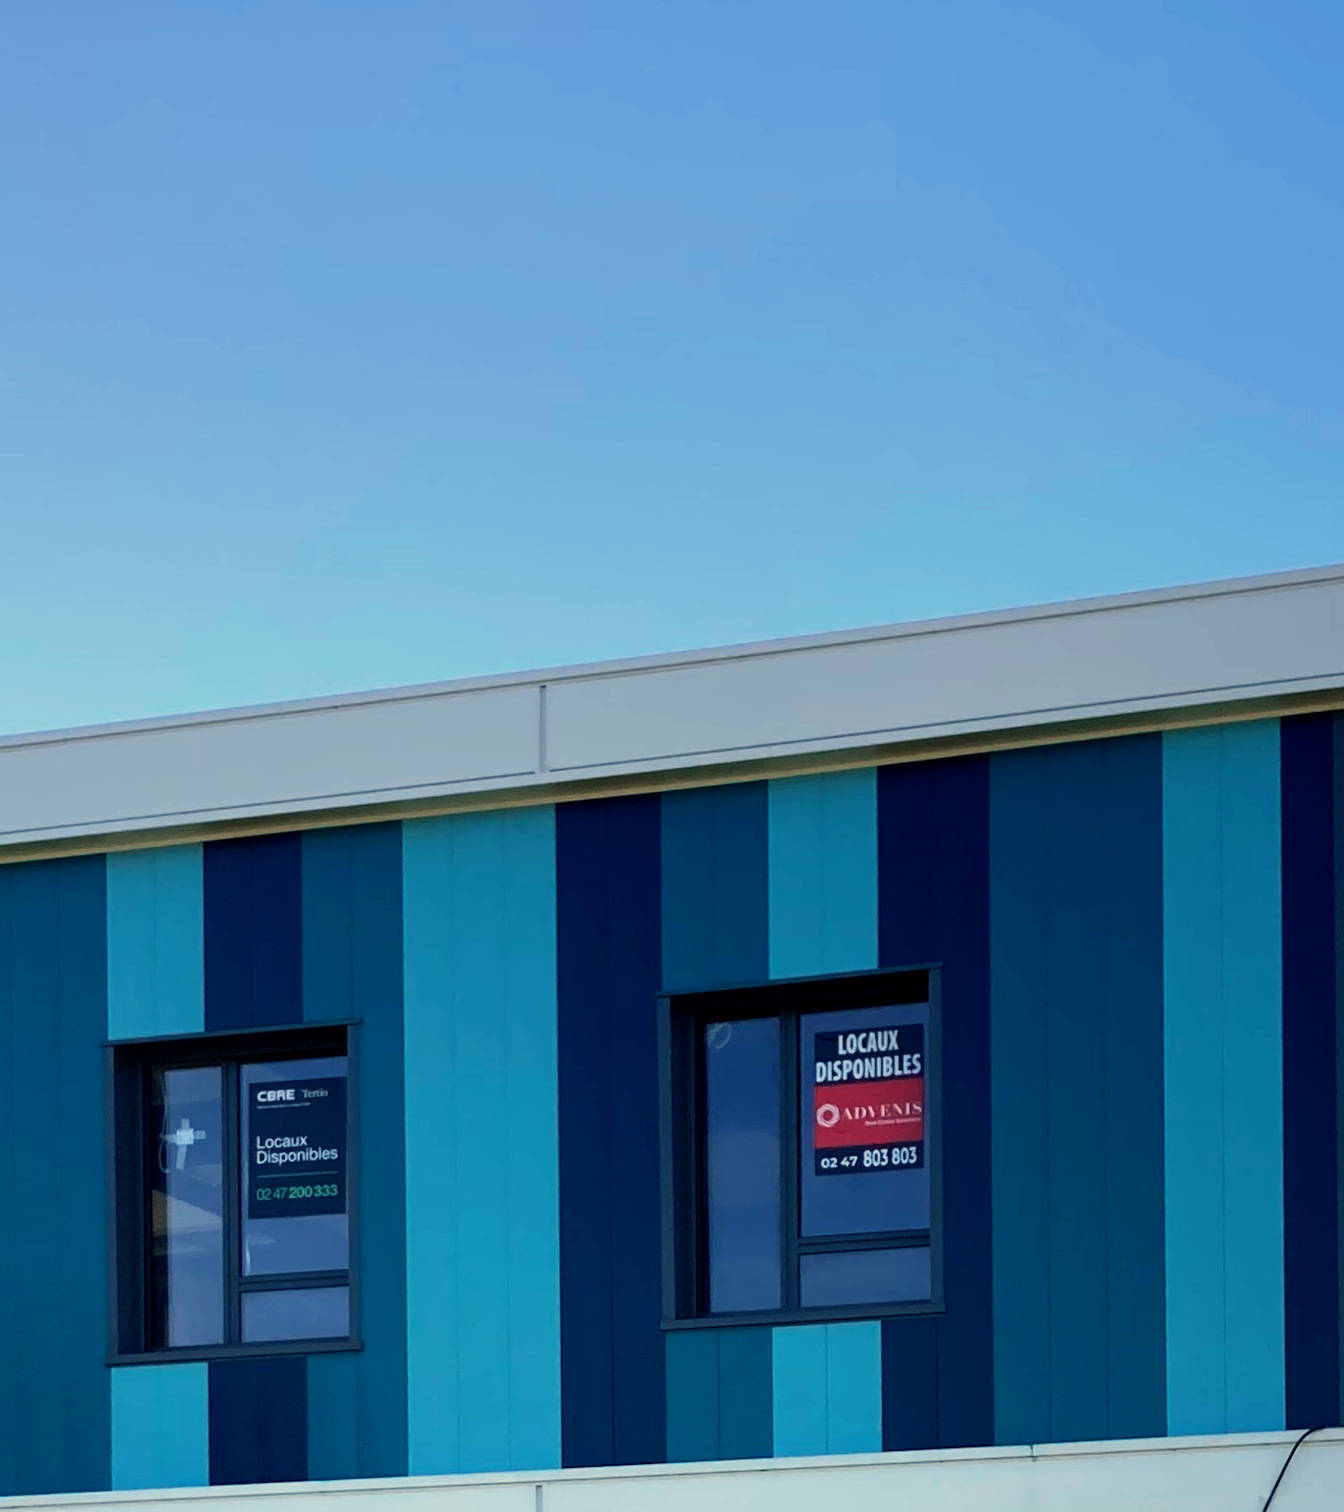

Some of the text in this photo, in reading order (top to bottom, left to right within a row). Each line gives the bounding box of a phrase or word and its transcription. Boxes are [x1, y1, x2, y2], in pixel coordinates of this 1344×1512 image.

[838, 1030, 898, 1055] LOCAUX
[816, 1053, 921, 1083] DISPONIBLES
[257, 1089, 295, 1102] CBRE
[843, 1102, 922, 1120] ADVENIS
[257, 1136, 307, 1149] Locaux
[257, 1147, 338, 1167] Disponibles
[821, 1146, 917, 1168] 02 47 803 803
[257, 1184, 337, 1200] 02 47 200 333
